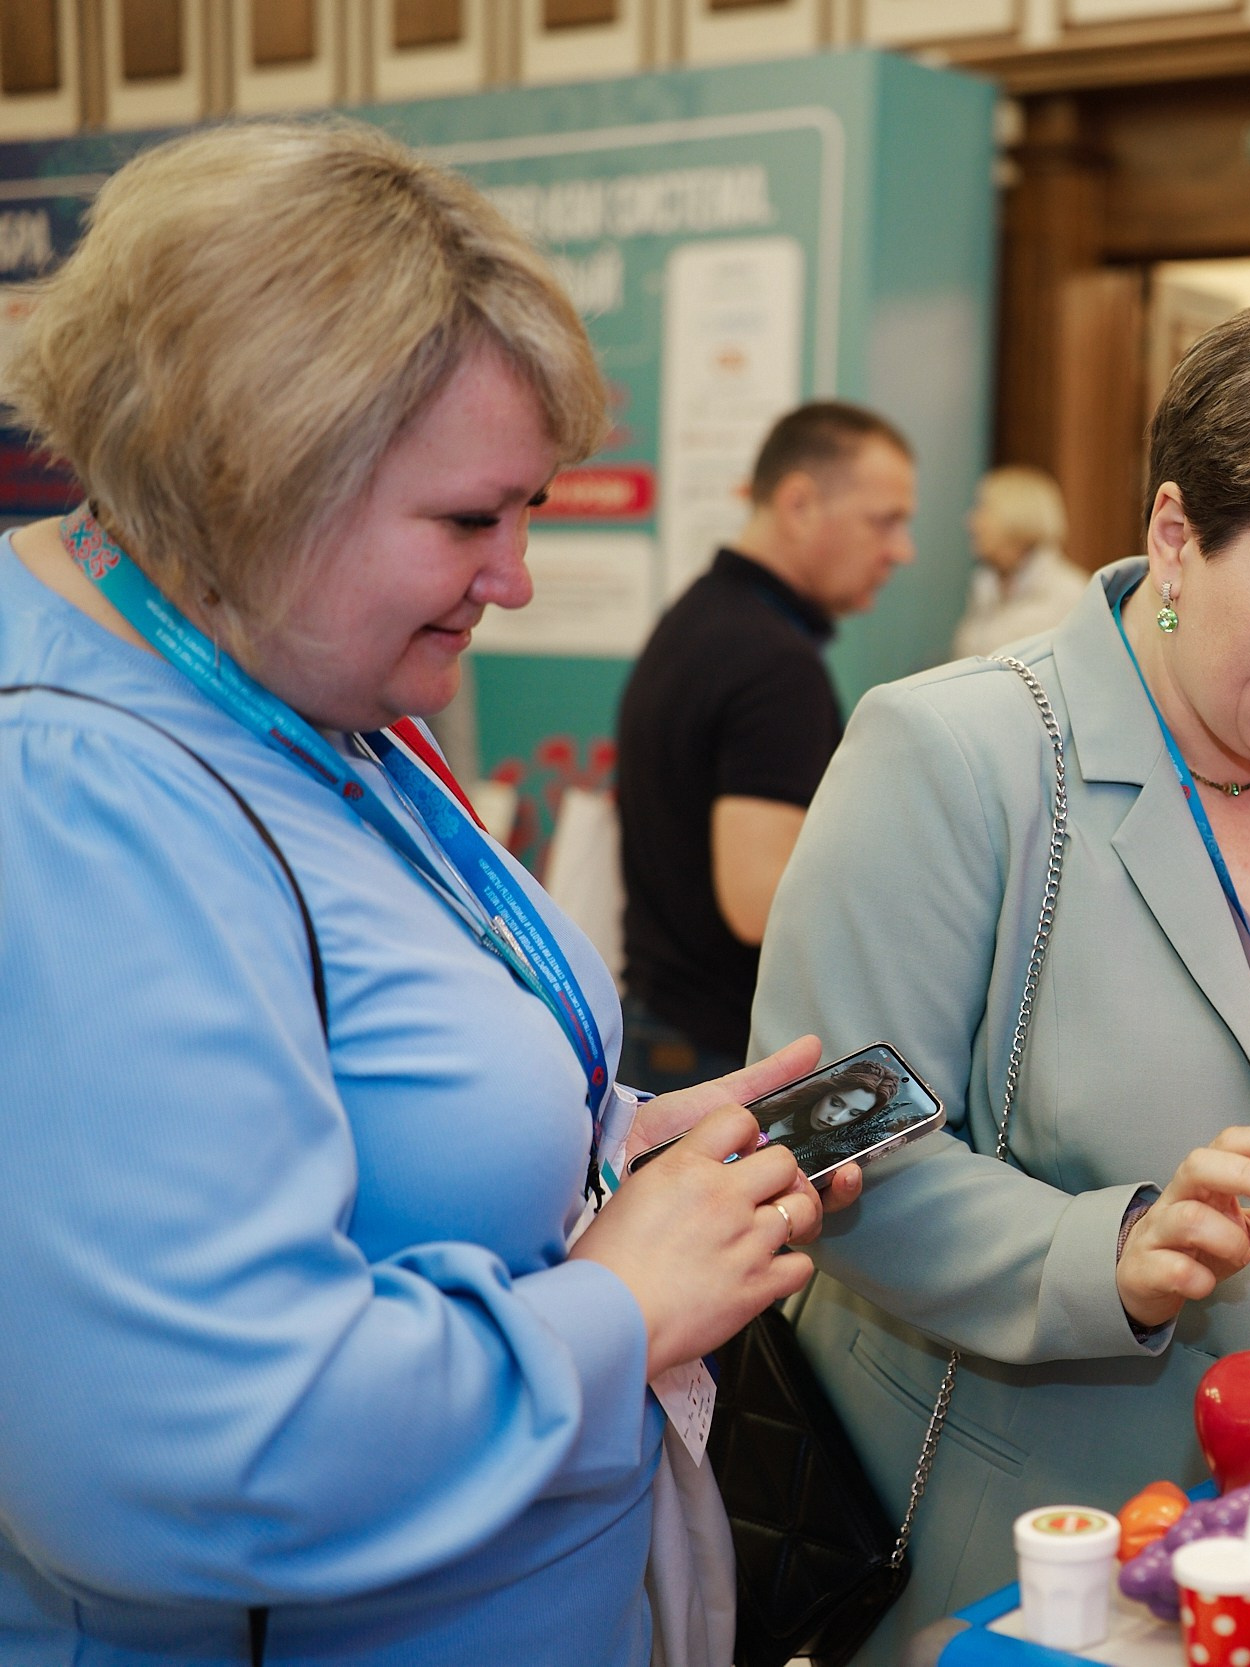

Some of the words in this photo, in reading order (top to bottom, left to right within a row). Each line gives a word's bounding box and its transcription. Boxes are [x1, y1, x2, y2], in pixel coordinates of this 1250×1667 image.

[482, 885, 501, 906] МОЗГА
[499, 886, 528, 923] ПРИОРИТЕТЫ
[495, 903, 519, 932] КОСТНОГО
[518, 933, 535, 954] КРОВИ
[525, 925, 546, 950] РАБОТЫ
[530, 951, 557, 983] ДОНОРСТВУ
[575, 1007, 586, 1020] КАК
